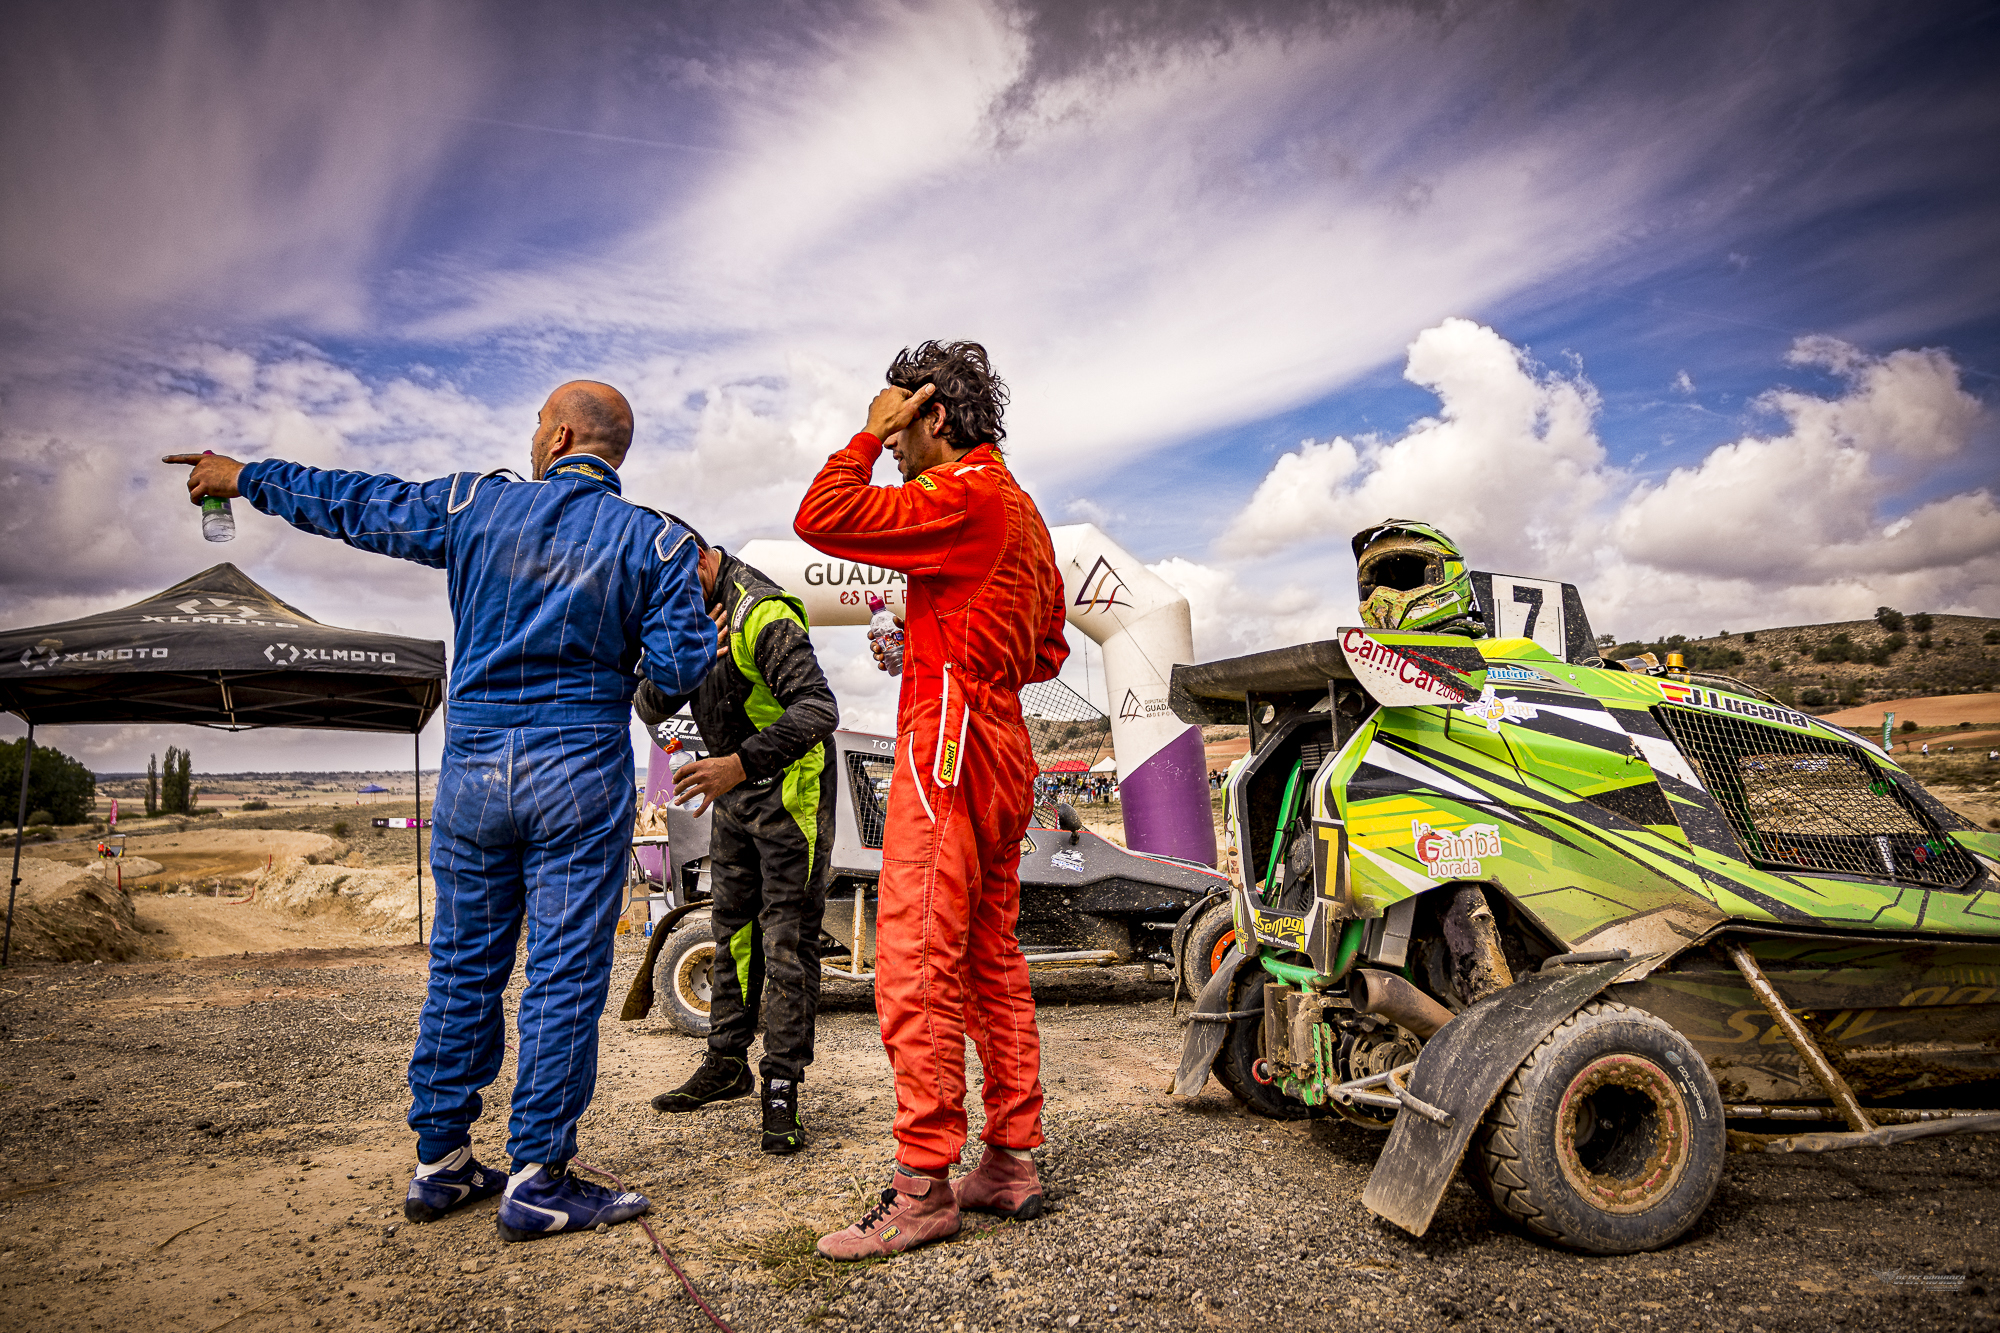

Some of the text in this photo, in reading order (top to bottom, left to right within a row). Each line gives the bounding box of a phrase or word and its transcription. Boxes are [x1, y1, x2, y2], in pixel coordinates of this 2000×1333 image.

[140, 615, 299, 629] XLMOTO
[1513, 585, 1543, 640] 7
[63, 648, 169, 662] XLMOTO
[303, 648, 396, 664] XLMOTO
[1684, 688, 1810, 729] J.Lucena
[943, 743, 956, 778] Sabelt
[1318, 826, 1339, 897] 7
[1430, 858, 1479, 876] Dorada
[1677, 1065, 1708, 1120] GOLDSPEED
